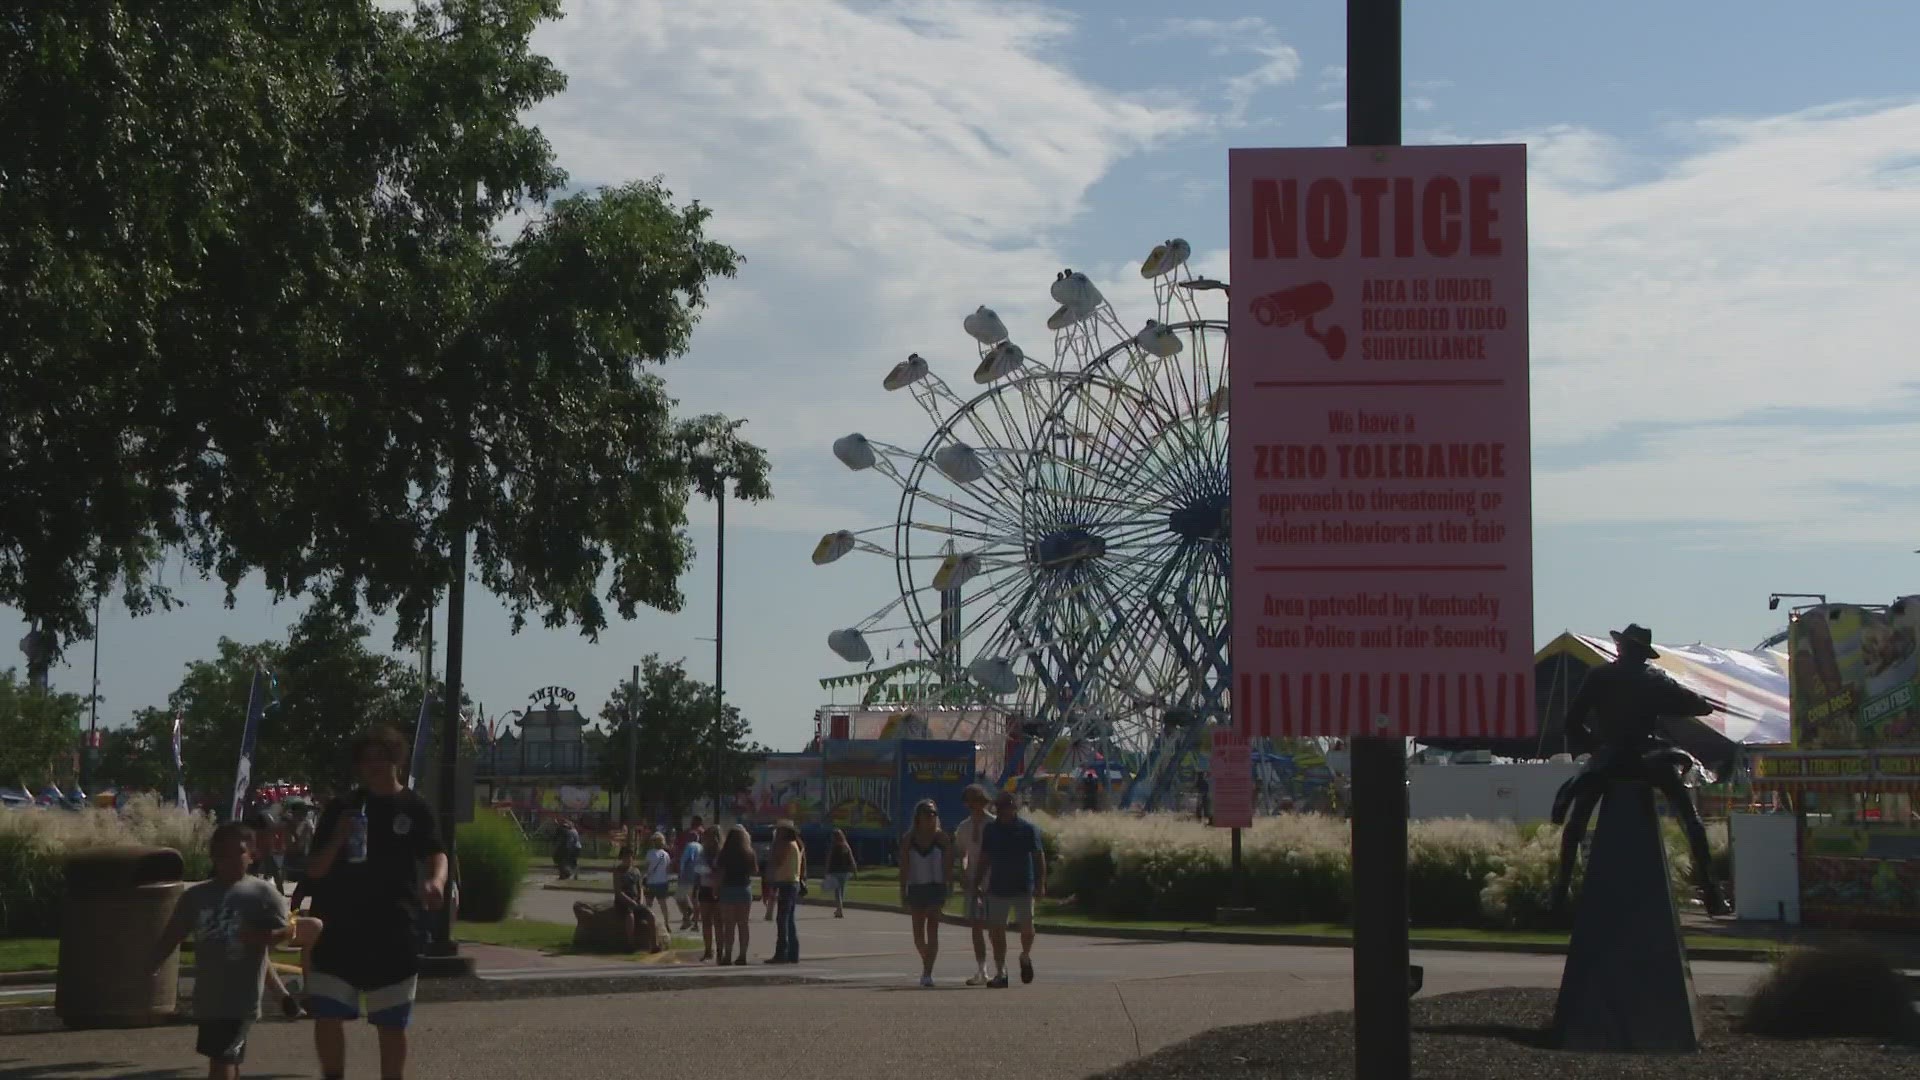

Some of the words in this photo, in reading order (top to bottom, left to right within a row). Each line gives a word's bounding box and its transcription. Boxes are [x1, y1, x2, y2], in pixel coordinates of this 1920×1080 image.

[1252, 175, 1502, 258] NOTICE
[1362, 279, 1405, 303] AREA
[1413, 279, 1429, 302] IS
[1435, 277, 1492, 302] UNDER
[1361, 307, 1450, 332] RECORDED
[1456, 306, 1507, 330] VIDEO
[1361, 336, 1486, 361] SURVEILLANCE
[1328, 410, 1353, 434] We
[1359, 408, 1399, 434] have
[1404, 414, 1416, 433] a
[1253, 445, 1327, 480] ZERO
[1336, 443, 1505, 479] TOLERANCE
[1258, 488, 1343, 518] approach
[1348, 489, 1365, 512] to
[1370, 488, 1476, 517] threatening
[1481, 494, 1502, 511] or
[1255, 521, 1317, 545] violent
[1322, 520, 1410, 545] behaviors
[1416, 522, 1434, 544] at
[1439, 519, 1467, 544] the
[1472, 519, 1505, 544] fair
[1263, 594, 1304, 616] Area
[1309, 593, 1387, 620] patrolled
[1392, 593, 1413, 622] by
[1419, 593, 1500, 621] Kentucky
[1256, 626, 1300, 648] State
[1304, 625, 1355, 648] Police
[1360, 625, 1392, 648] and
[1397, 625, 1428, 648] Fair
[1434, 625, 1508, 653] Security
